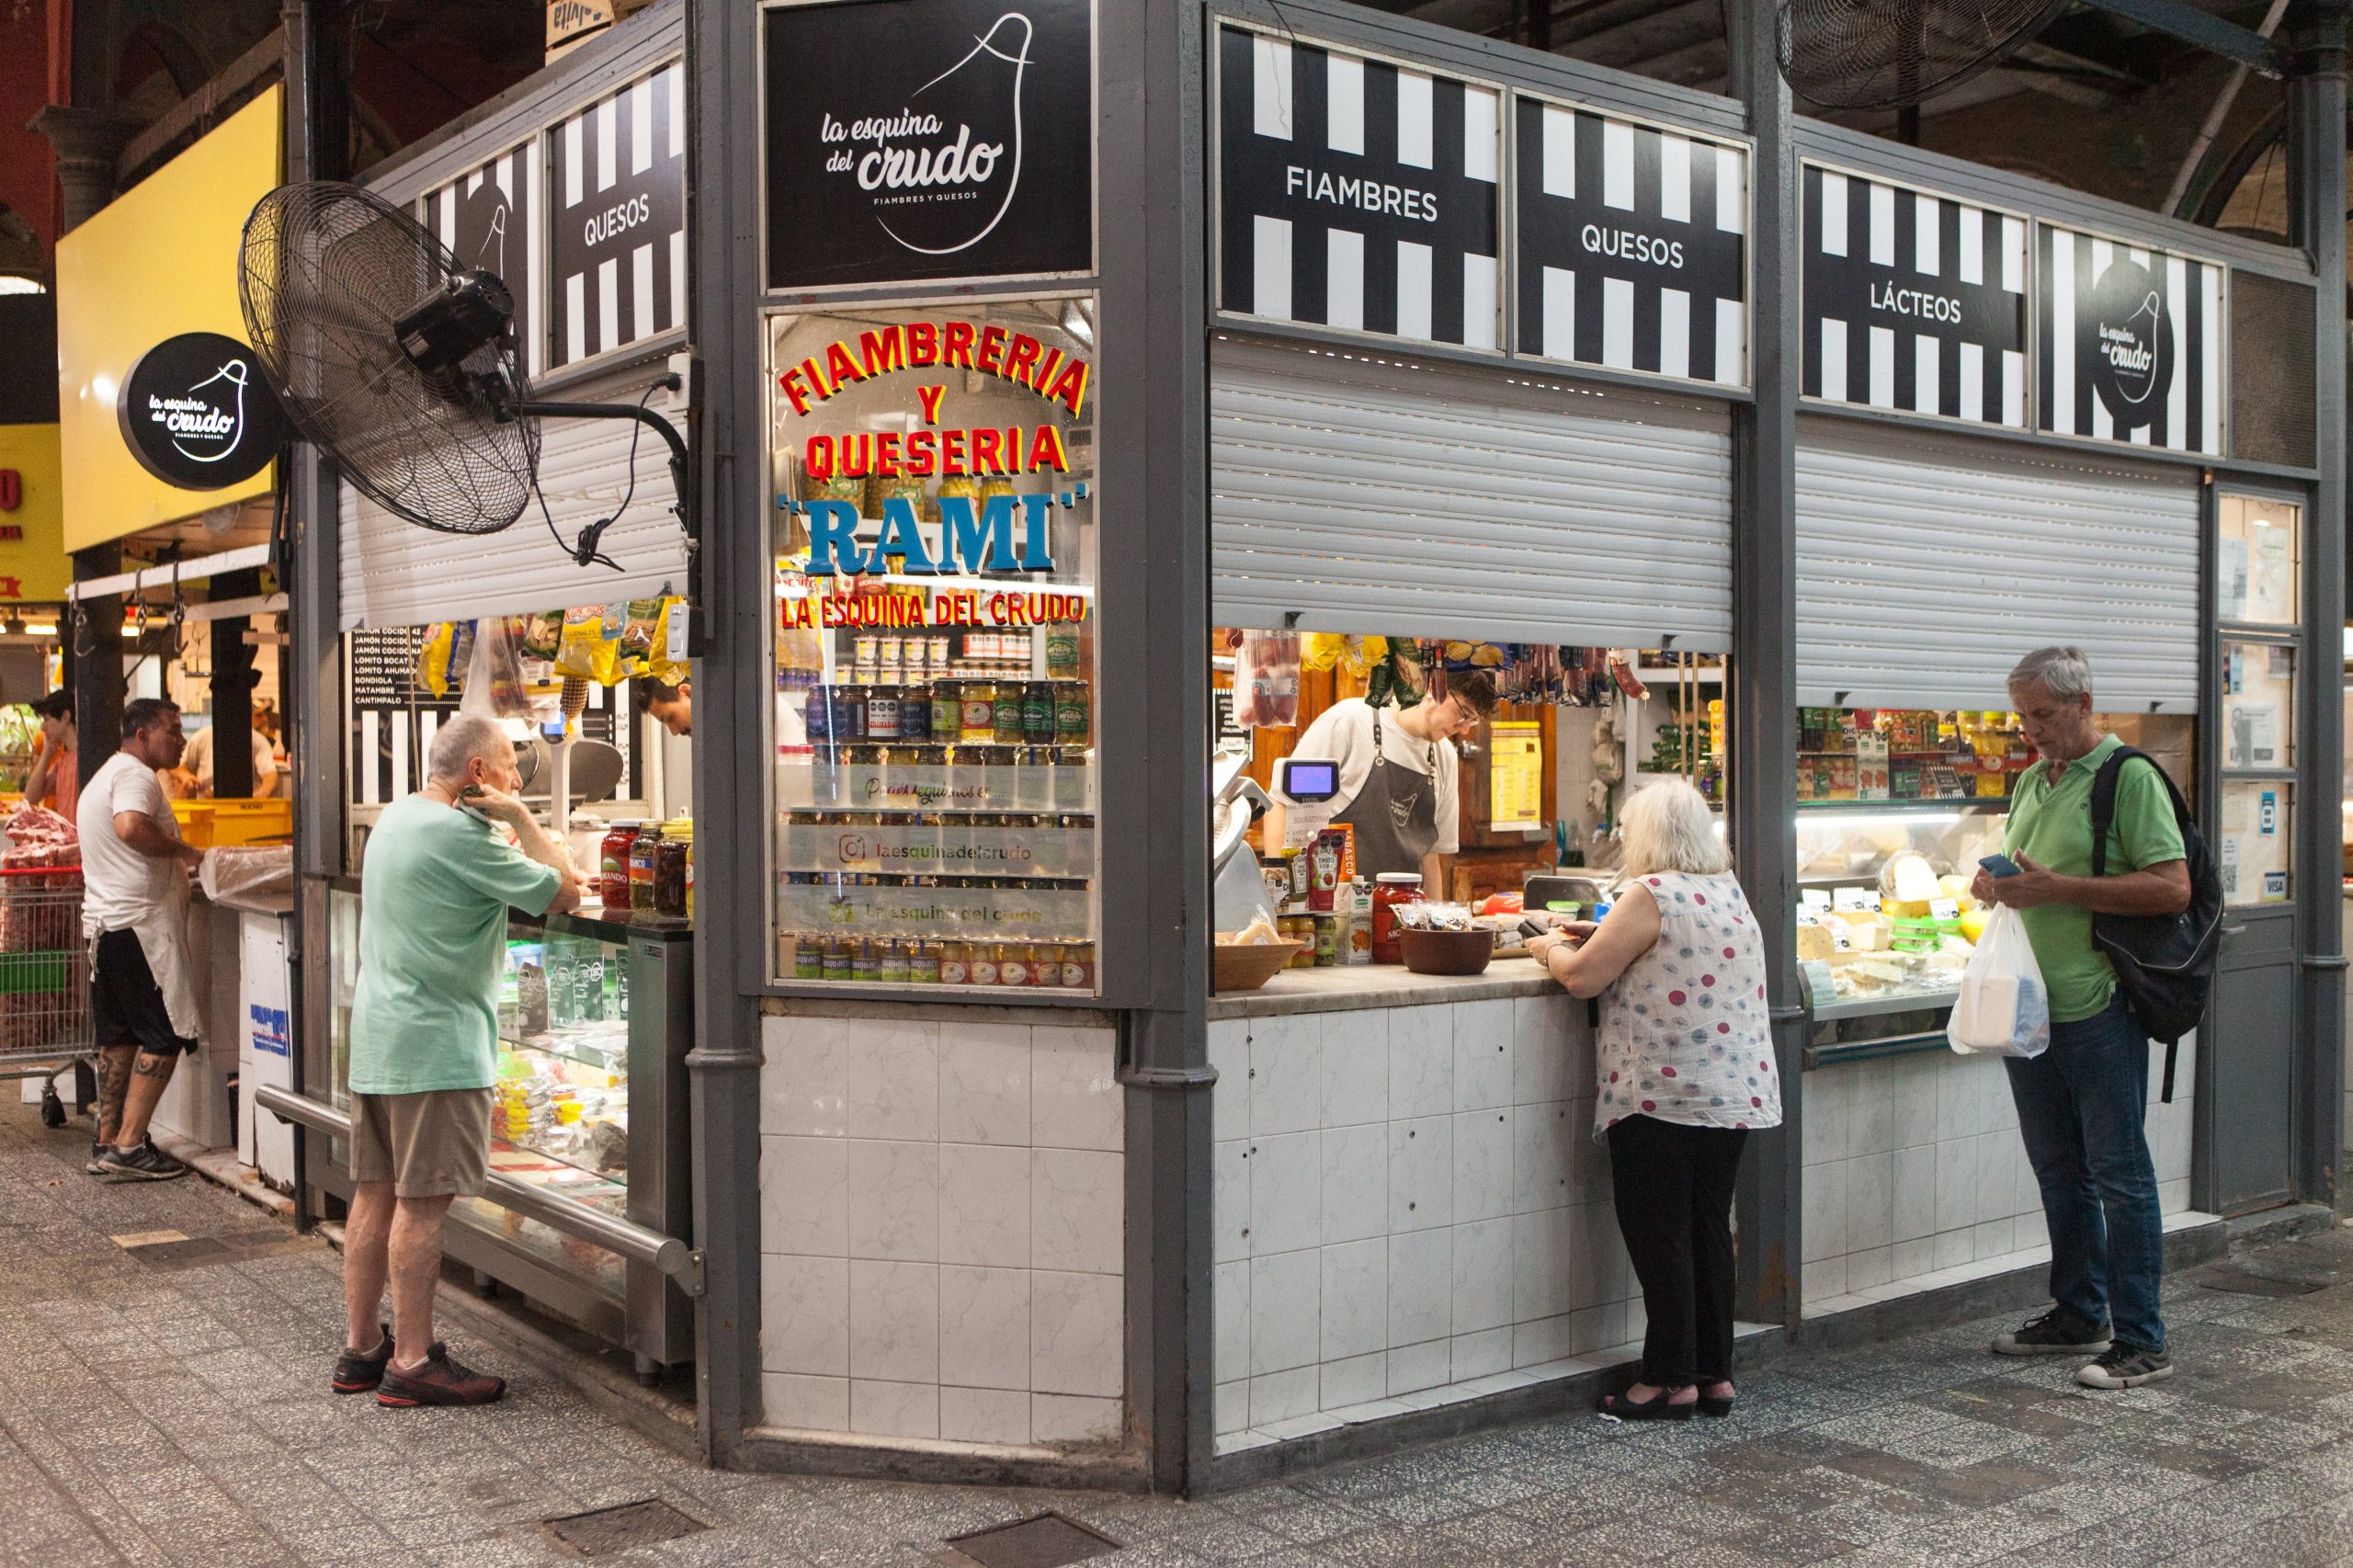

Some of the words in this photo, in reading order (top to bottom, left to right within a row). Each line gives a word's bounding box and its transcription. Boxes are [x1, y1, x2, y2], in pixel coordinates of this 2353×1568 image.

[822, 113, 848, 143] la
[851, 108, 943, 151] esquina
[825, 150, 854, 173] del
[858, 124, 1004, 191] crudo
[873, 194, 925, 206] FIAMBRES
[926, 194, 934, 204] Y
[936, 191, 978, 202] QUESOS
[1287, 165, 1438, 222] FIAMBRES
[585, 193, 650, 247] QUESOS
[1581, 223, 1685, 269] QUESOS
[1870, 280, 1961, 324] LÁCTEOS
[779, 321, 1090, 420] FIAMBRERIA
[2109, 340, 2153, 371] crudo
[149, 393, 164, 410] la
[164, 396, 208, 415] esquina
[915, 384, 947, 426] Y
[152, 411, 166, 423] del
[167, 406, 235, 434] crudo
[805, 424, 1070, 485] QUESERIA
[781, 593, 814, 631] LA
[821, 593, 928, 631] ESQUINA
[935, 593, 985, 630] DEL
[990, 591, 1087, 628] CRUDO
[354, 636, 381, 644] JAMÓN
[354, 646, 381, 654] JAMÓN
[354, 656, 382, 665] LOMITO
[354, 666, 382, 675] LOMITO
[355, 676, 392, 685] BONDIOLA
[355, 687, 395, 695] MATAMBRE
[876, 843, 1031, 860] laesquinadelcrudo
[1344, 829, 1354, 874] TABASCO
[2267, 879, 2283, 893] VISA
